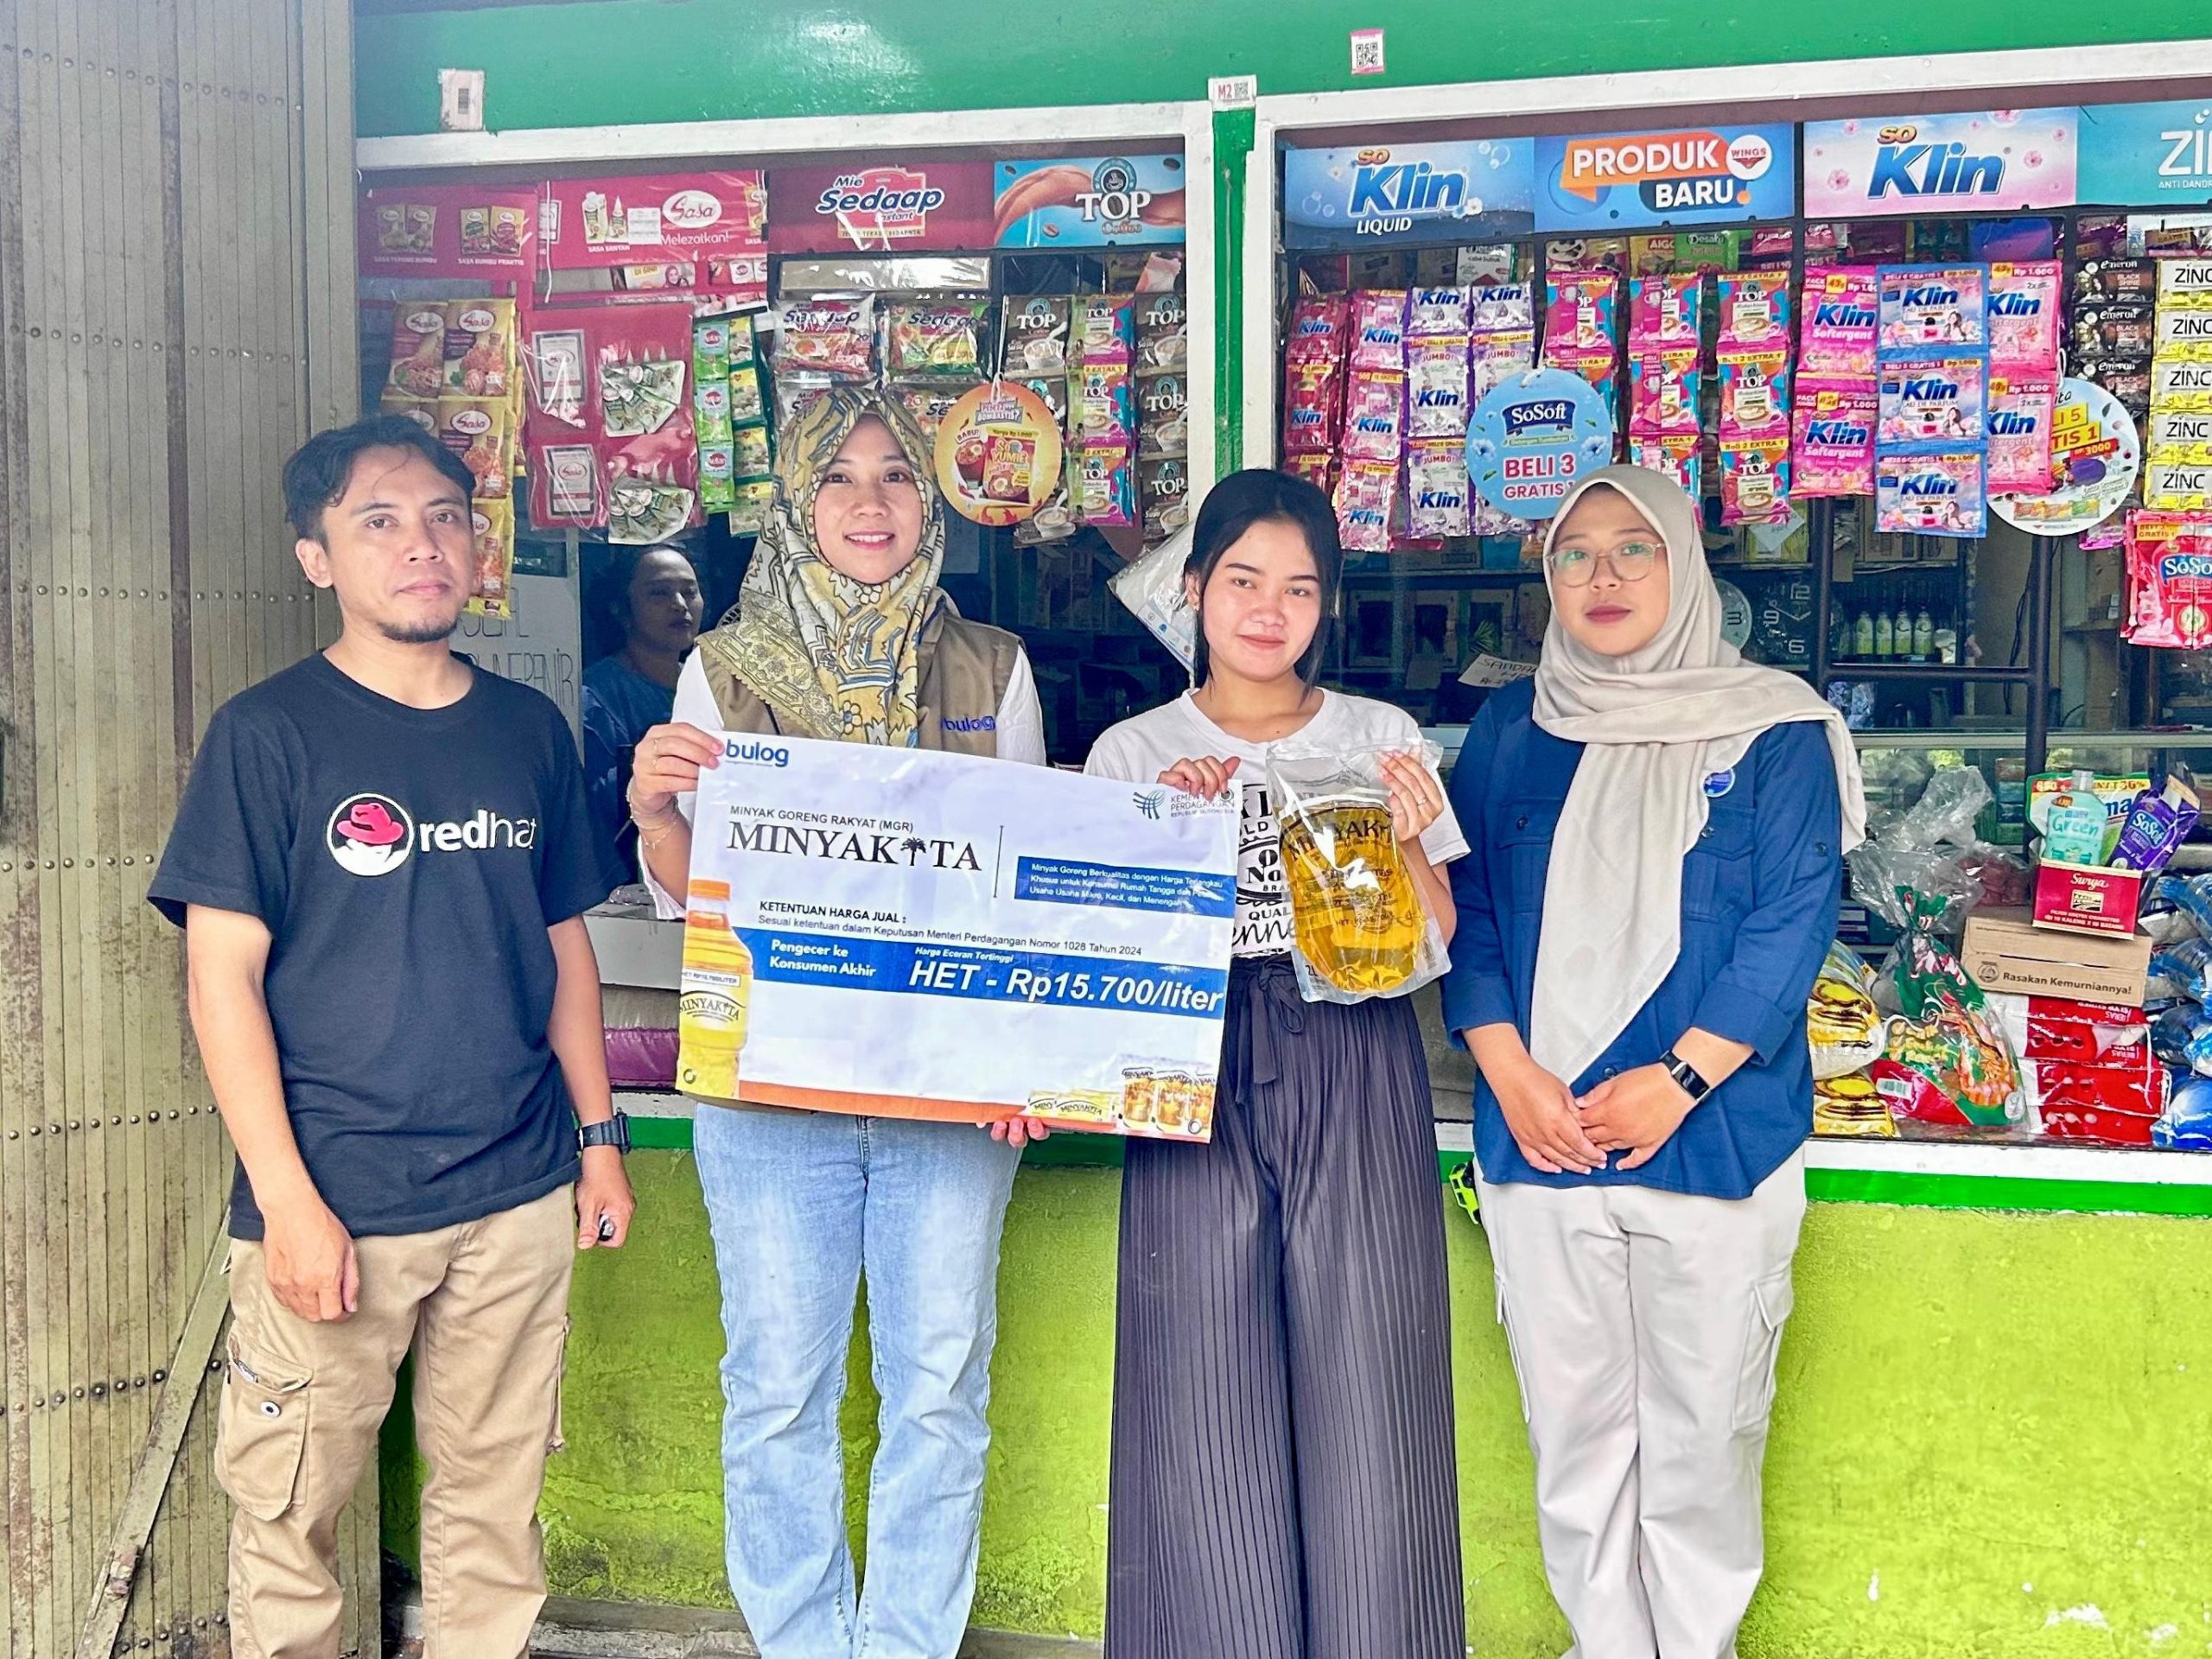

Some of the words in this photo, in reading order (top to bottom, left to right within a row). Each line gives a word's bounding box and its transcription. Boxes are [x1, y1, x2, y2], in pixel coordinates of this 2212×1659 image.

[1218, 84, 1232, 99] M2
[1573, 138, 1720, 178] PRODUK
[1732, 148, 1767, 158] WINGS
[1867, 142, 2006, 199] Klin
[836, 176, 862, 188] Mie
[1350, 162, 1466, 215] Klin
[818, 188, 943, 213] Sedaap
[1656, 179, 1733, 208] BARU
[671, 195, 715, 220] Sasa
[1076, 191, 1151, 221] TOP
[1357, 217, 1412, 235] LIQUID
[1420, 289, 1459, 305] Klin
[1481, 289, 1522, 302] Klin
[1735, 291, 1767, 302] TOP
[1903, 287, 1958, 306] Klin
[1087, 308, 1113, 317] TOP
[1146, 309, 1185, 326] TOP
[1815, 304, 1875, 327] Klin
[1017, 314, 1057, 329] TOP
[1299, 321, 1332, 333] Klin
[1364, 328, 1399, 344] Klin
[1736, 376, 1767, 388] TOP
[2170, 370, 2211, 385] ZINC
[1903, 378, 1958, 400] Klin
[1147, 394, 1185, 411] TOP
[1419, 390, 1459, 407] Klin
[456, 416, 486, 429] Sasa
[1293, 410, 1322, 424] Klin
[2071, 408, 2081, 422] 5
[1357, 416, 1394, 434] Klin
[1806, 422, 1866, 444] Klin
[2088, 427, 2097, 440] 1
[2167, 422, 2209, 437] ZINC
[2086, 443, 2111, 455] 3000
[1505, 455, 1553, 478] BELI
[1561, 454, 1575, 474] 3
[1739, 463, 1770, 475] TOP
[1152, 478, 1185, 495] TOP
[1901, 474, 1957, 495] Klin
[2163, 474, 2205, 489] ZINC
[1420, 492, 1460, 508] Klin
[1505, 484, 1564, 499] GRATIS
[1350, 509, 1384, 526] Klin
[726, 739, 789, 767] bulog
[730, 805, 775, 818] MINYAK
[779, 810, 828, 823] GORENG
[831, 815, 876, 829] RAKYAT
[879, 819, 913, 833] (MGR)
[2052, 813, 2099, 836] Green
[419, 809, 537, 853] redhat
[1032, 864, 1058, 874] Minyak
[1060, 866, 1087, 877] Goreng
[1090, 868, 1129, 880] Berkualitas
[1132, 872, 1159, 882] dengan
[1160, 874, 1184, 885] Harga
[2070, 873, 2108, 890] Surya
[1031, 875, 1058, 885] Khusus
[1060, 878, 1080, 887] untuk
[1121, 882, 1147, 892] Rumah
[1148, 885, 1175, 896] Tangga
[1030, 887, 1054, 895] Usaha
[1056, 888, 1080, 898] Usaha
[1128, 895, 1141, 904] dan
[760, 901, 827, 917] KETENTUAN
[830, 907, 869, 920] HARGA
[872, 912, 899, 923] JUAL
[758, 915, 791, 927] Sesuai
[793, 918, 840, 931] ketentuan
[842, 923, 871, 934] dalam
[874, 925, 924, 939] Keputusan
[926, 929, 962, 941] Menteri
[964, 932, 1027, 949] Perdagangan
[1029, 938, 1060, 950] Nomor
[1064, 941, 1086, 951] 1028
[1090, 943, 1116, 954] Tahun
[1119, 945, 1141, 956] 2024
[772, 938, 830, 957] Pengecer
[833, 944, 849, 957] ke
[915, 946, 941, 958] Harga
[943, 949, 973, 960] Eceran
[975, 951, 1014, 963] Tertinggi
[770, 956, 836, 976] Konsumen
[839, 962, 877, 977] Akhir
[909, 960, 980, 992] HET
[1006, 967, 1224, 1014] Rp15.700/liter
[2003, 972, 2048, 985] Rasakan
[2050, 977, 2132, 995] Kemurniannya!
